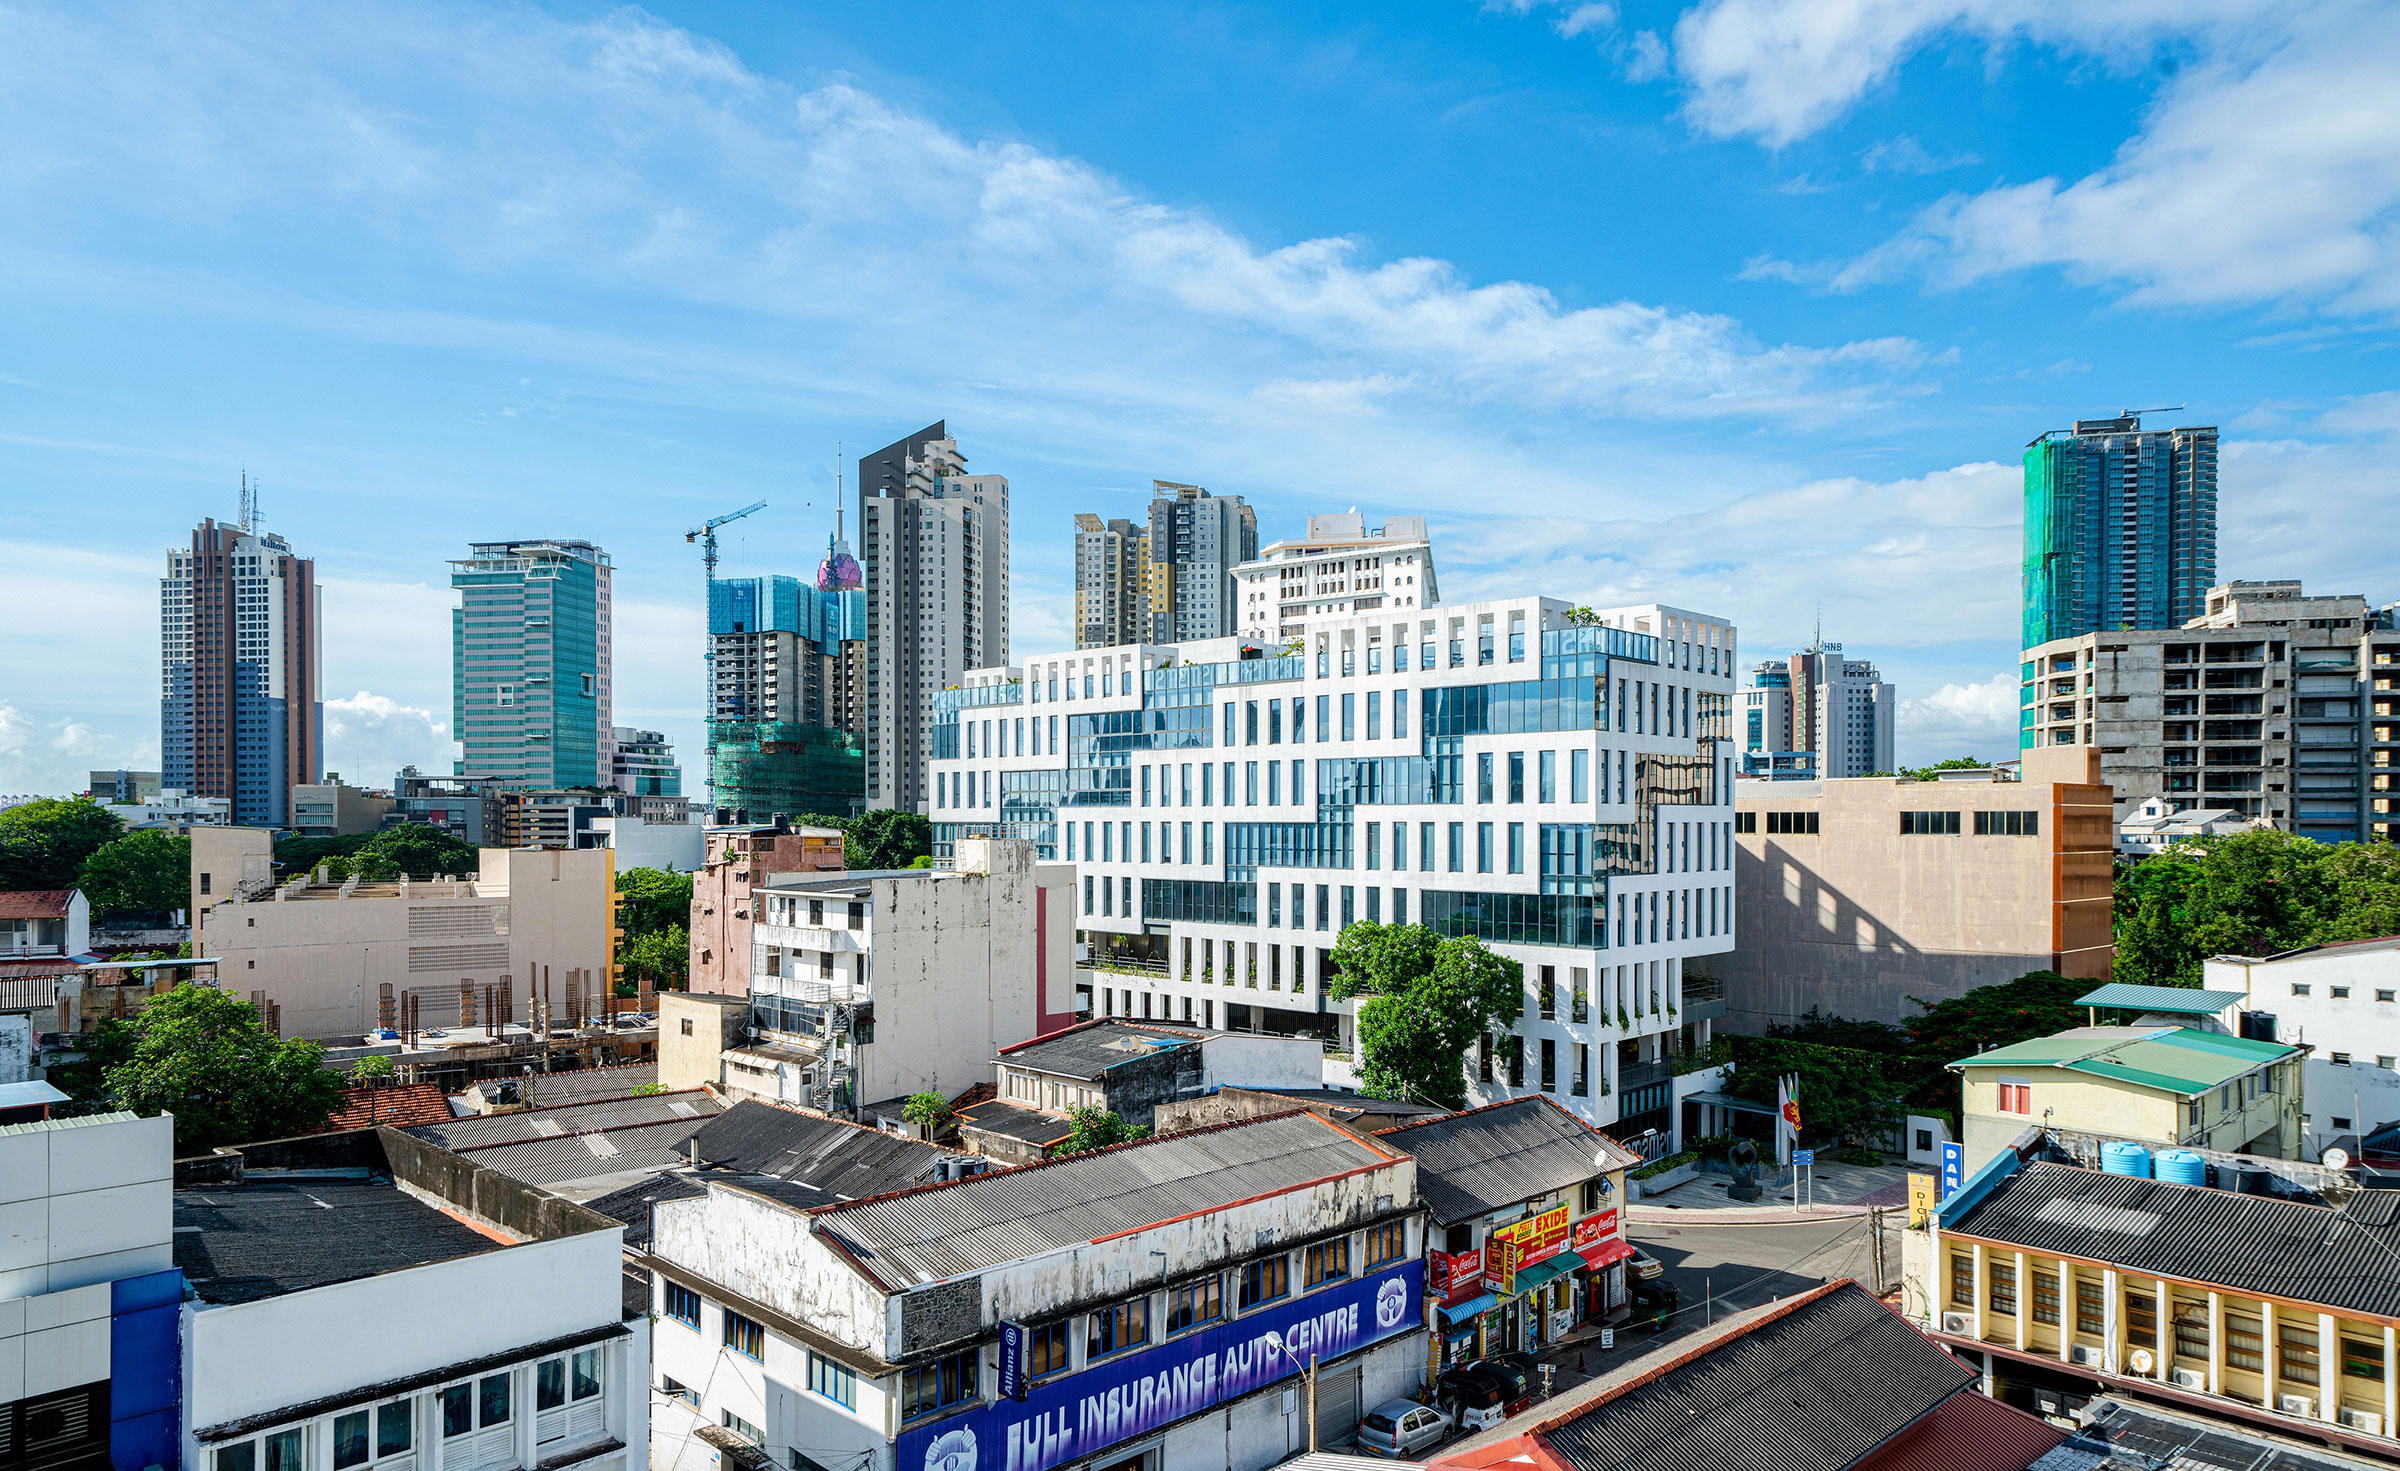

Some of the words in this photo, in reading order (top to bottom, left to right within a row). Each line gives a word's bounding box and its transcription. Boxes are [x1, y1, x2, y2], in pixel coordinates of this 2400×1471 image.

[261, 538, 287, 551] Hilton
[1824, 642, 1842, 651] HNB
[1536, 1207, 1568, 1234] EXIDE
[1506, 1245, 1514, 1276] EXIDE
[1005, 1347, 1014, 1396] Allianz
[1007, 1405, 1072, 1461] FULL
[1079, 1352, 1217, 1431] INSURANCE
[1286, 1302, 1359, 1353] CENTRE
